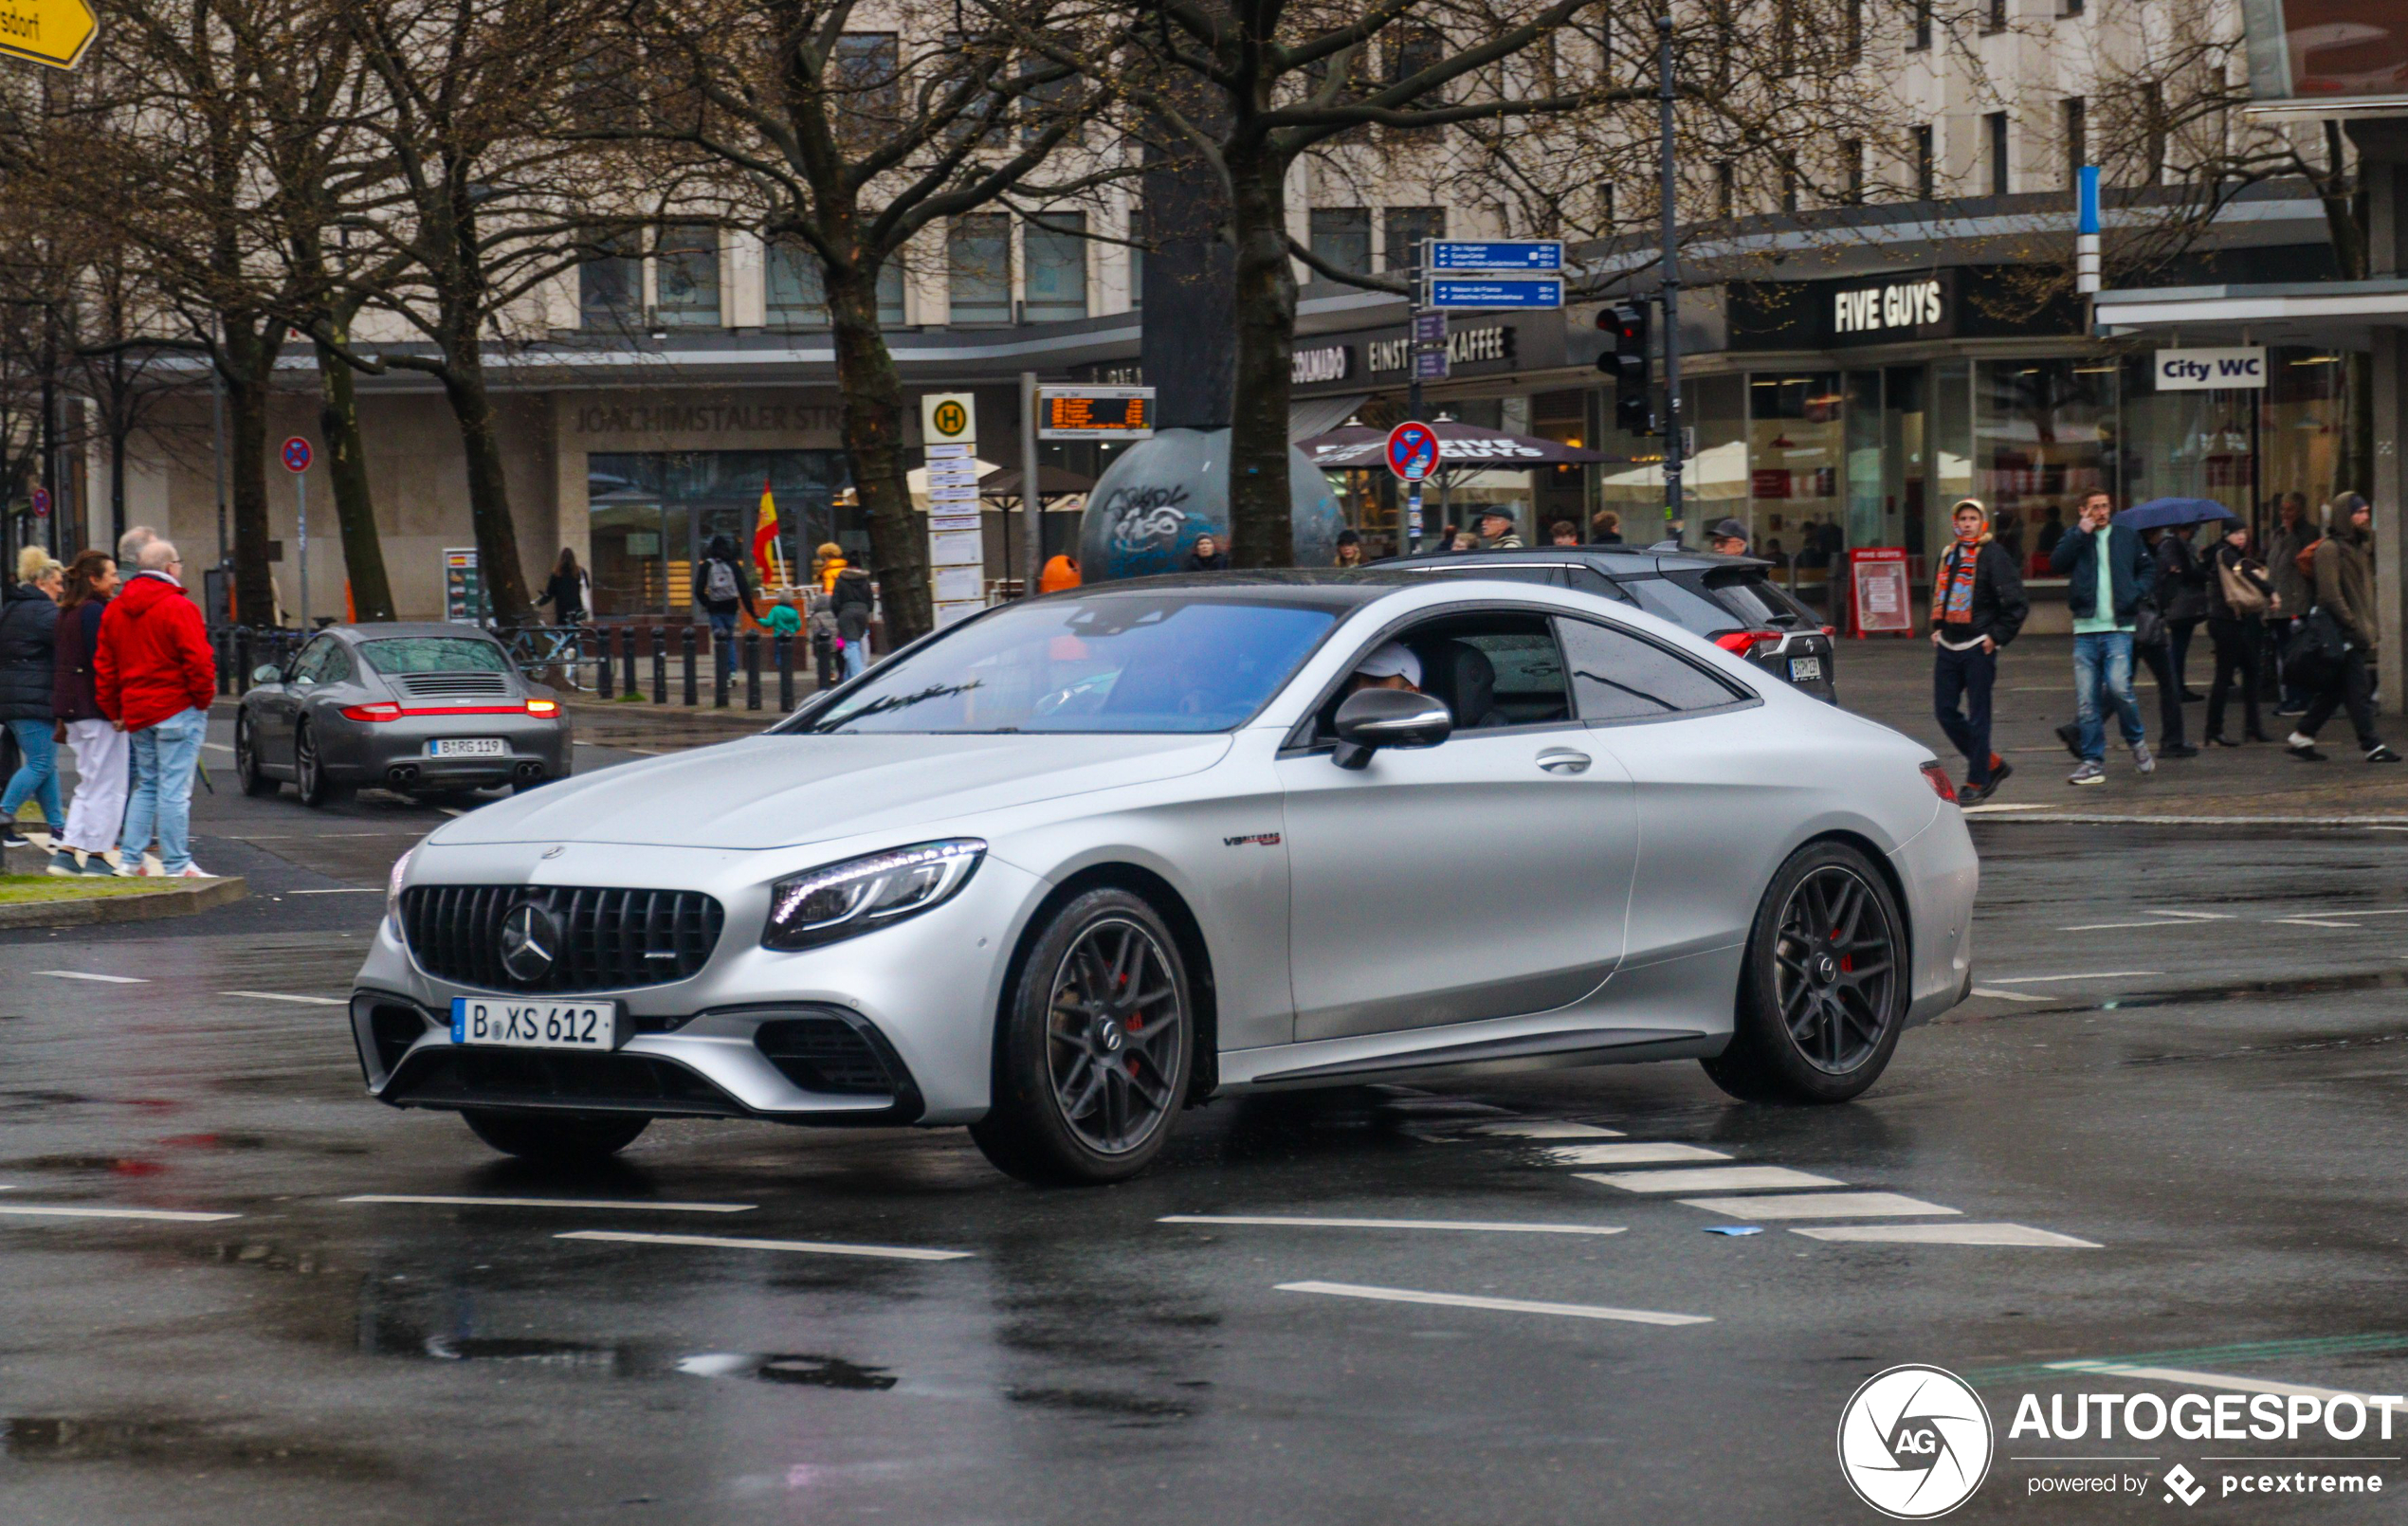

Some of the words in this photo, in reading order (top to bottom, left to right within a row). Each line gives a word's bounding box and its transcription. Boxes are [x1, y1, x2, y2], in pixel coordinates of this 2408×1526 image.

[1834, 288, 1880, 333] FIVE
[1883, 280, 1941, 328] GUYS
[1447, 327, 1505, 364] KAFFEE
[2163, 360, 2211, 381] City
[2218, 359, 2259, 376] WC
[576, 406, 786, 432] JOACHIMSTALER
[942, 409, 958, 427] H
[1438, 440, 1522, 448] FIVE
[1439, 447, 1543, 457] GUYS
[442, 742, 450, 754] B
[458, 741, 474, 753] RG
[476, 740, 499, 753] 119
[474, 1005, 488, 1038] B
[506, 1007, 538, 1040] XS
[547, 1008, 597, 1043] 612
